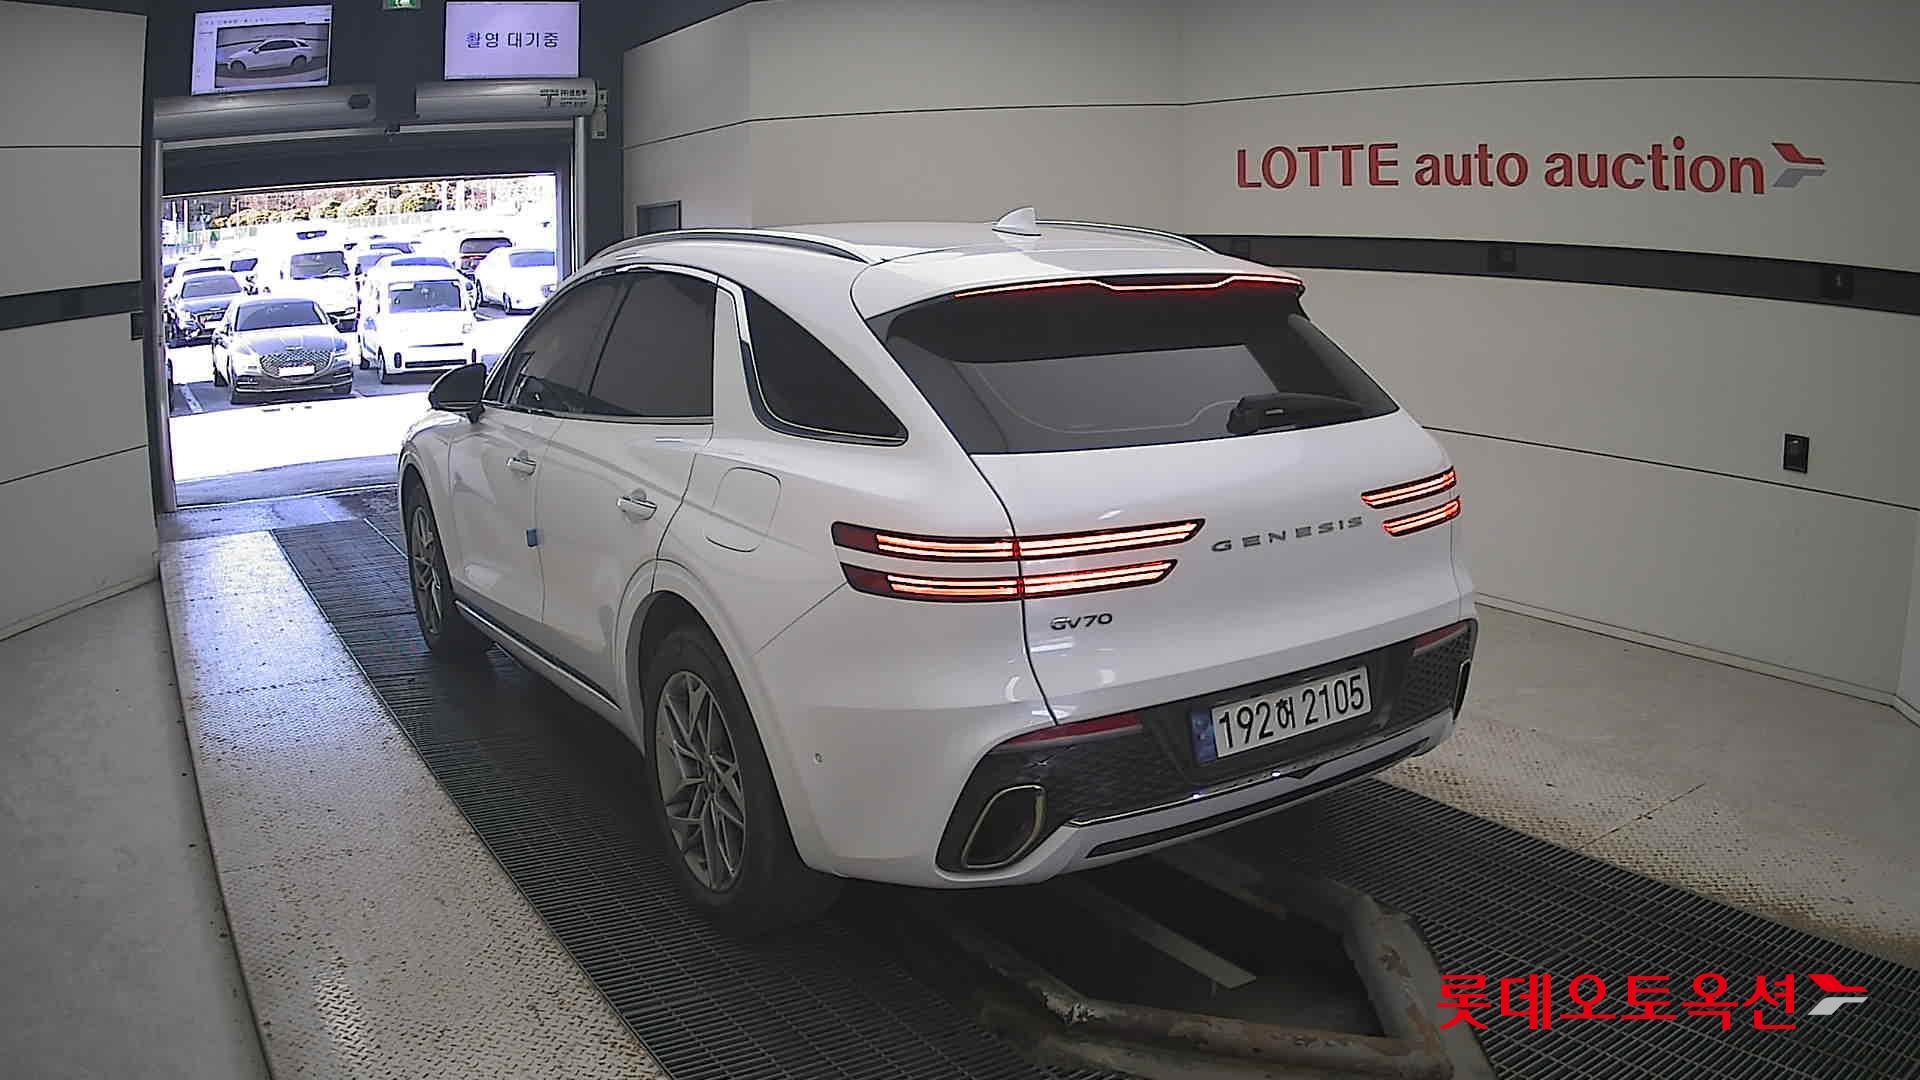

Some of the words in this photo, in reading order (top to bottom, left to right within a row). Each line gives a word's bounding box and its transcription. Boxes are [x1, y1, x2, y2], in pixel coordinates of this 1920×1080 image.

[507, 32, 559, 48] 대기중
[1237, 143, 1399, 189] LOTTE
[1414, 143, 1528, 187] auto
[1544, 136, 1765, 194] auction
[1211, 516, 1362, 552] GENESIS
[1050, 613, 1113, 630] GV70
[1302, 674, 1364, 725] 2105
